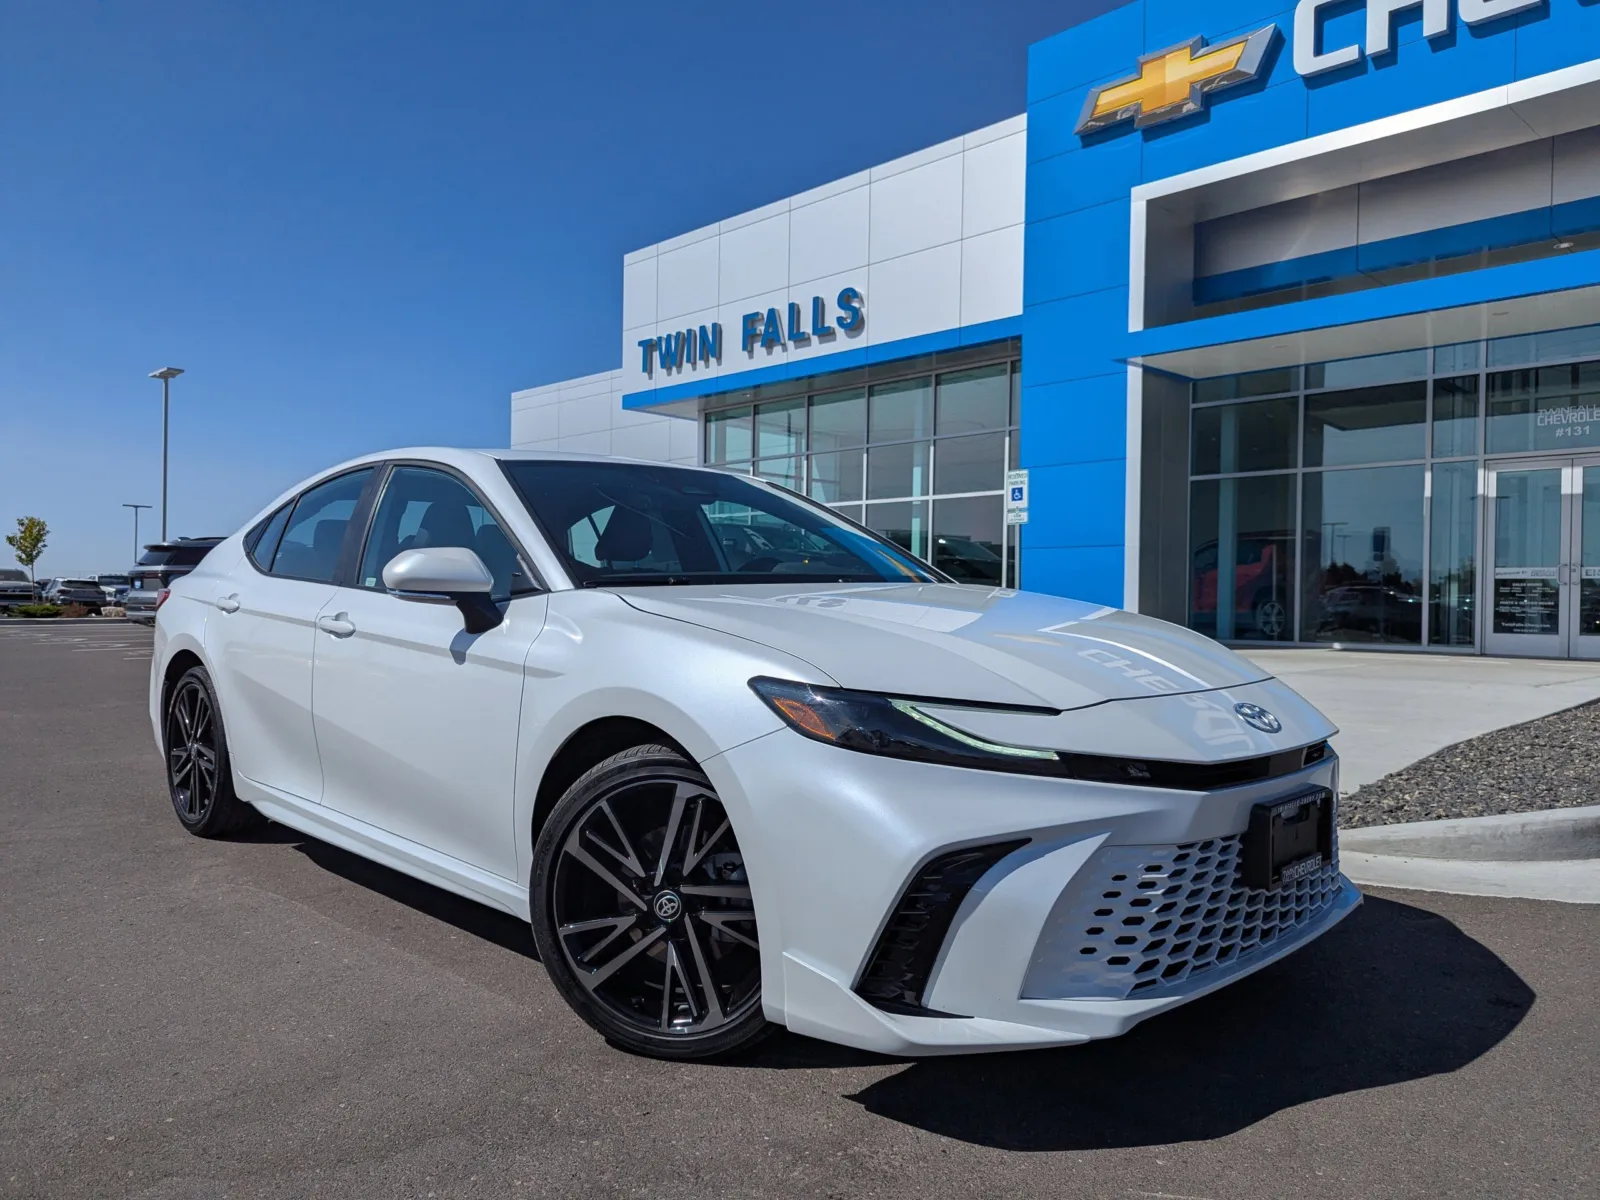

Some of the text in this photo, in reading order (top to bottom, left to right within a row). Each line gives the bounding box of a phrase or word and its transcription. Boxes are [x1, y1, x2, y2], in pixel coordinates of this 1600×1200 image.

[1293, 0, 1543, 77] CH
[638, 287, 864, 378] TWIN FALLS
[1555, 425, 1590, 438] #131
